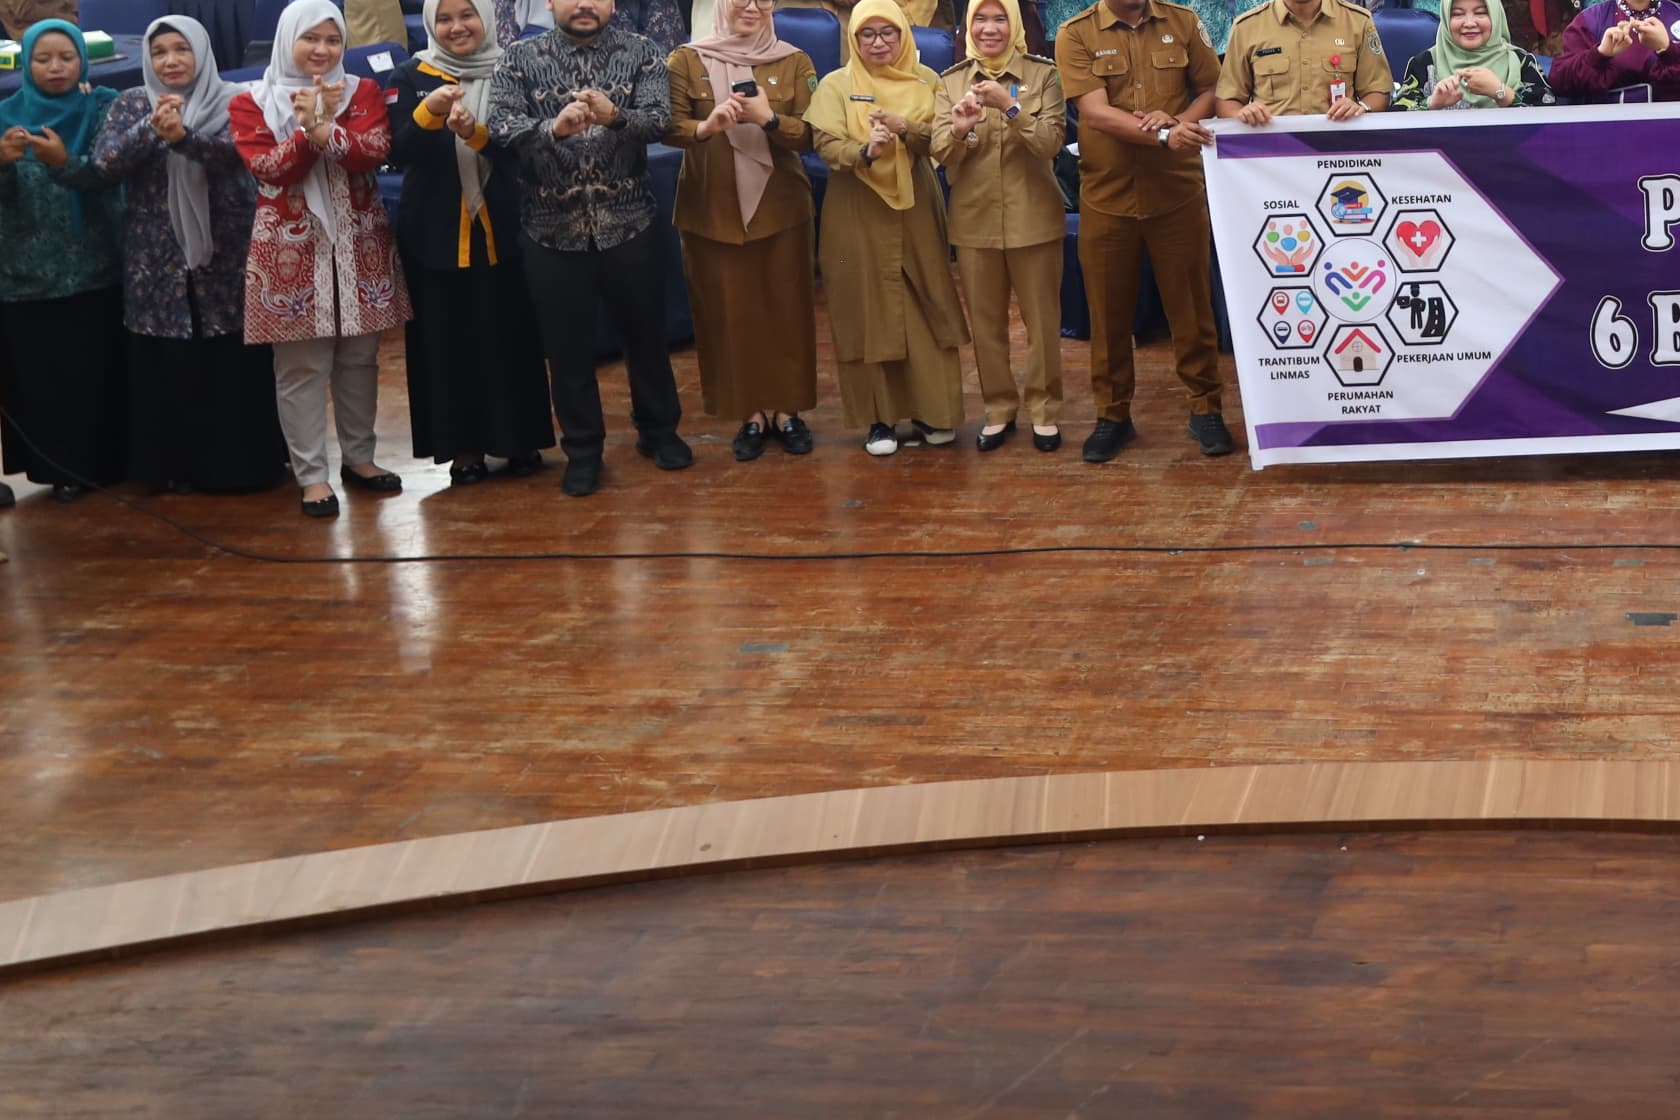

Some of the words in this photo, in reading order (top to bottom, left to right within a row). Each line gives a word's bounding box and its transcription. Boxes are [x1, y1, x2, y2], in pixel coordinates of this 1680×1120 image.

[1316, 158, 1382, 169] PENDIDIKAN
[1263, 199, 1300, 210] SOSIAL
[1391, 193, 1452, 205] KESEHATAN
[1590, 295, 1638, 369] 6
[1258, 356, 1320, 367] TRANTIBUM
[1396, 353, 1454, 364] PEKERJAAN
[1457, 351, 1492, 362] UMUM
[1270, 370, 1310, 381] LINMAS
[1327, 389, 1394, 401] PERUMAHAN
[1341, 404, 1381, 415] RAKYAT
